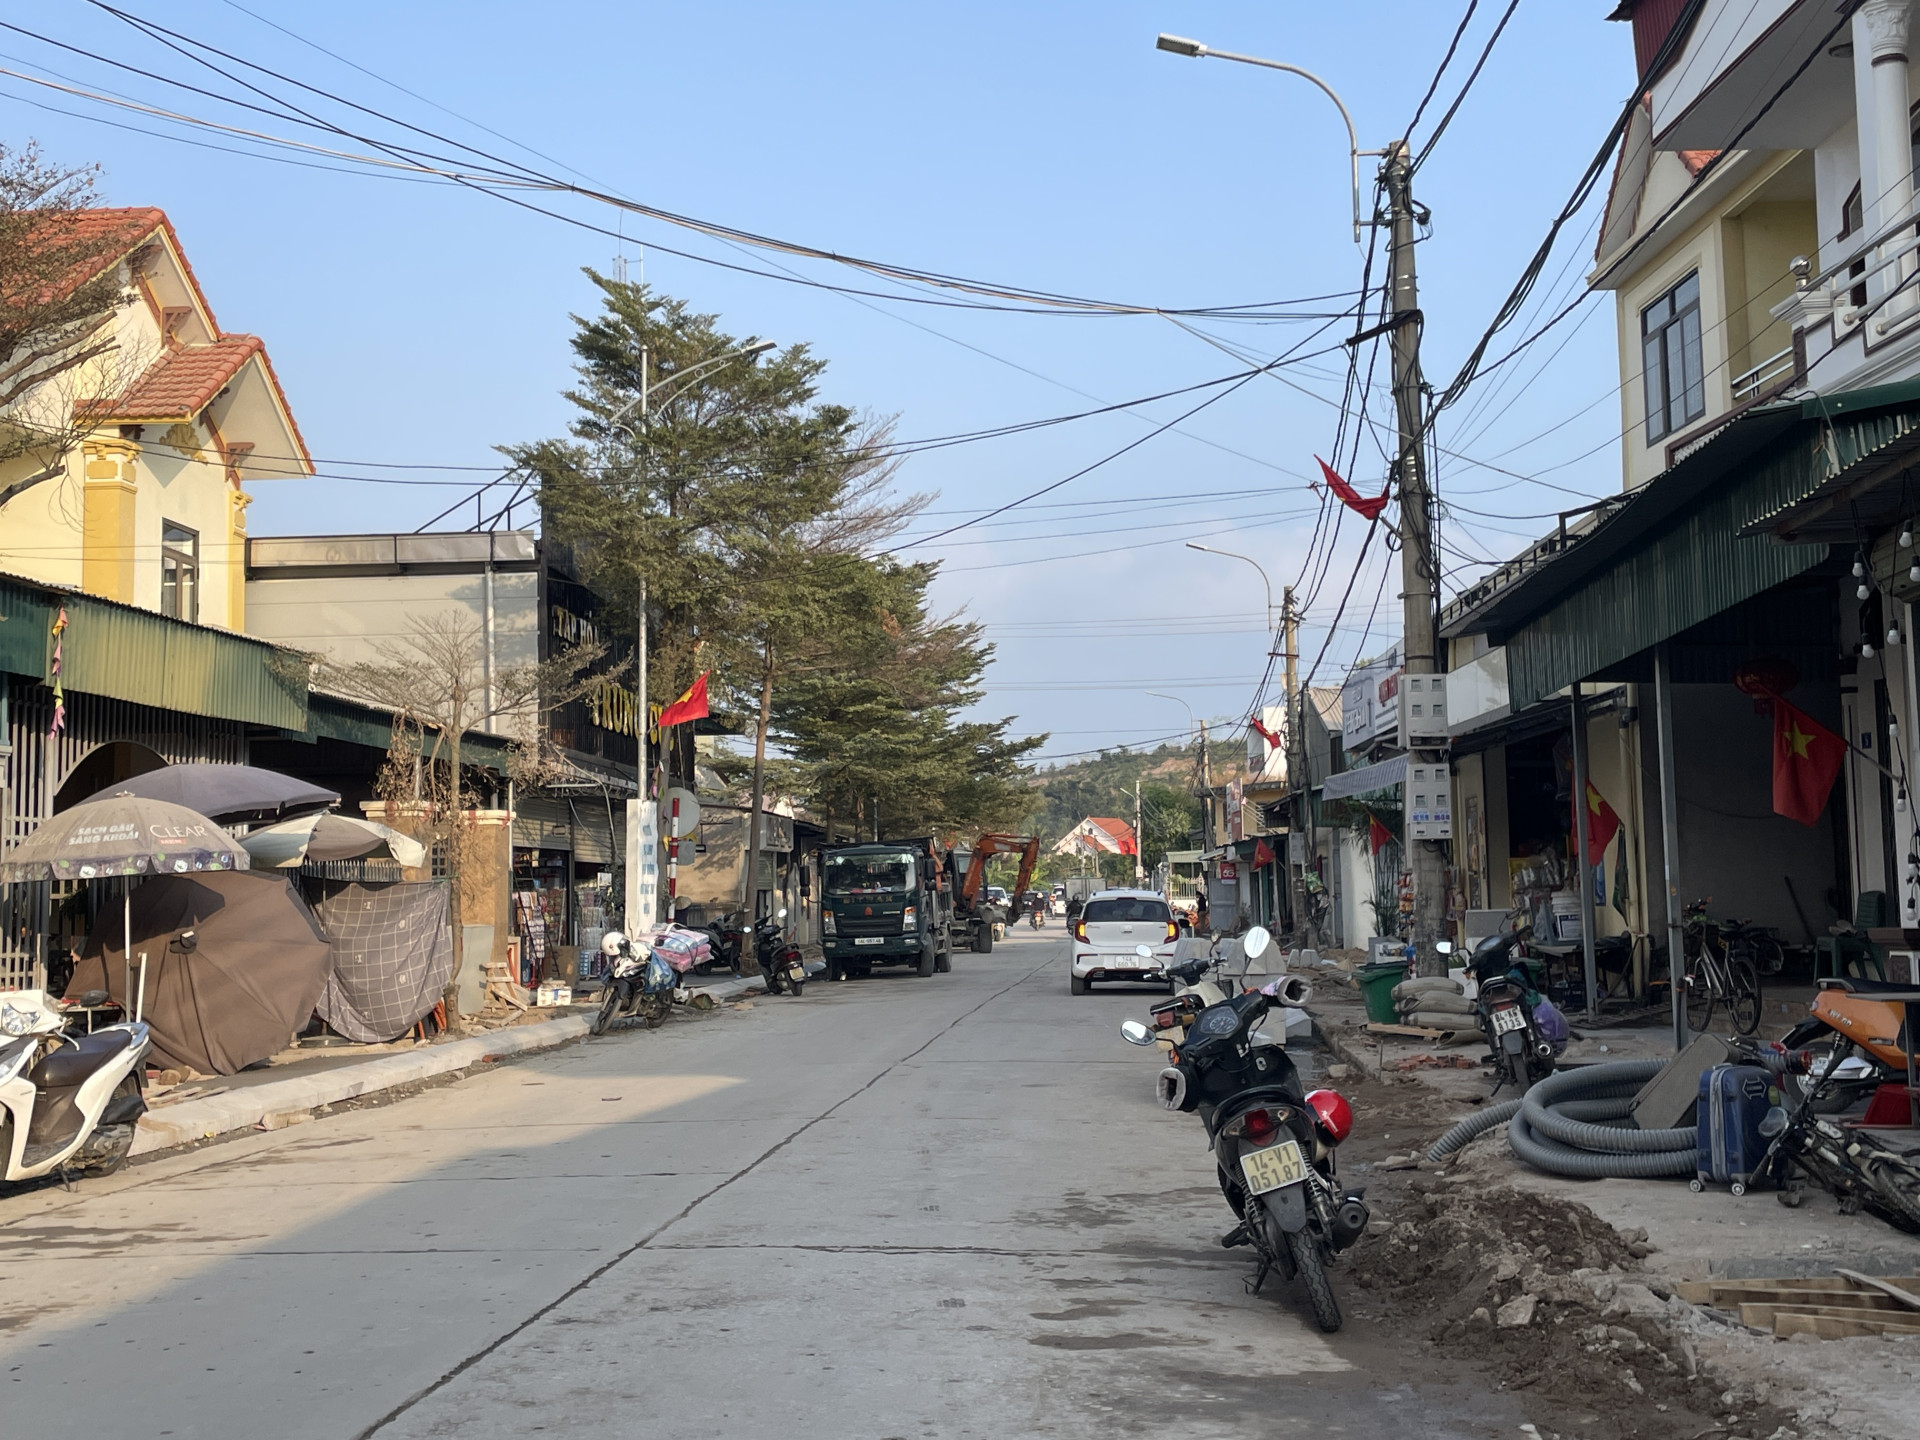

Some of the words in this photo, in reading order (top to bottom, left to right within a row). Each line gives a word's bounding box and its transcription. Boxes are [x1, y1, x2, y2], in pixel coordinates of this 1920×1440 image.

[150, 824, 208, 838] CLEAR
[1250, 1146, 1292, 1172] 14-V1
[1250, 1161, 1301, 1191] 051.87
